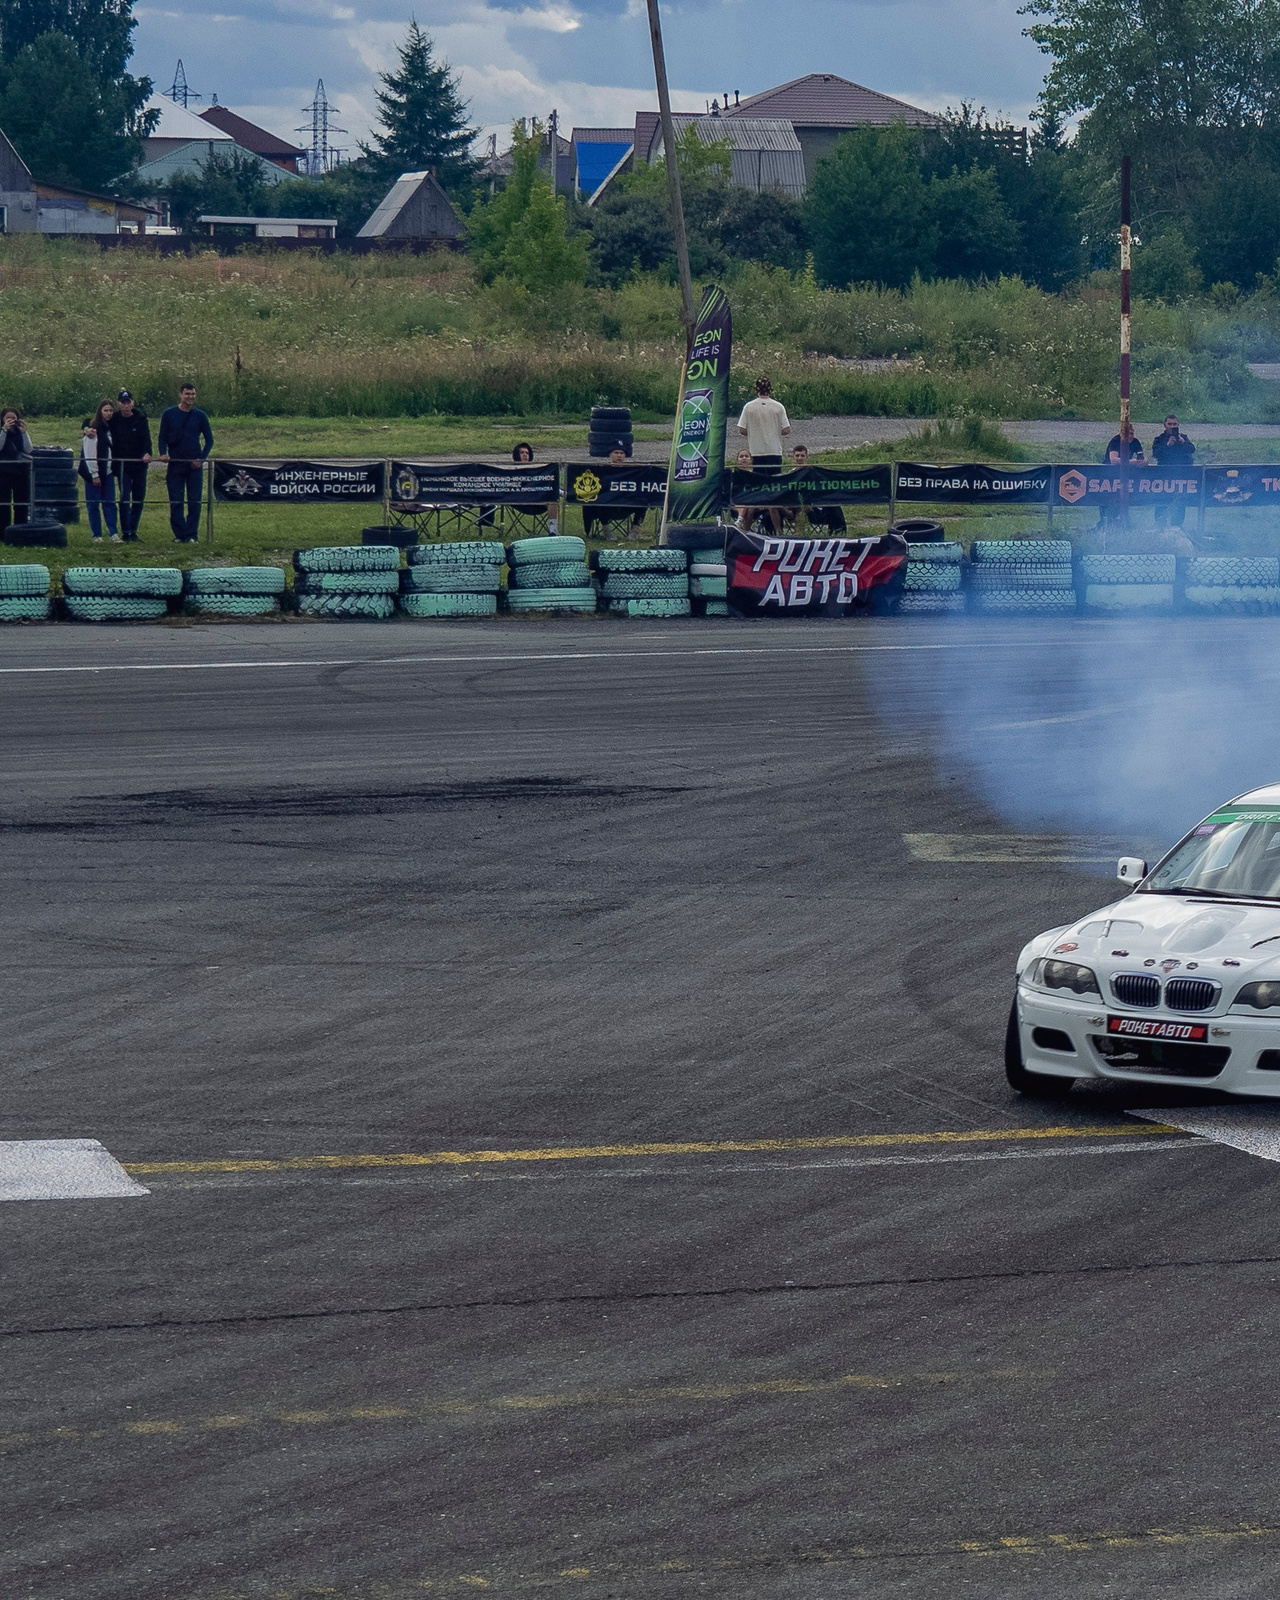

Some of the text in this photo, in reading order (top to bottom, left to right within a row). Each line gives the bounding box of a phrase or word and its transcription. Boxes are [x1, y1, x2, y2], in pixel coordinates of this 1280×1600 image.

[693, 328, 722, 347] EON
[690, 344, 720, 360] LIFE IS
[687, 358, 718, 381] ON
[684, 419, 706, 430] EON
[683, 428, 705, 437] ENERGY
[682, 460, 699, 468] KIWI
[275, 471, 368, 481] ИНЖЕНЕРНЫЕ
[679, 467, 700, 477] BLAST
[270, 482, 376, 494] ВОЙСКА РОССИИ
[609, 481, 637, 492] БЕЗ
[819, 479, 880, 491] ТЮМЕНЬ
[898, 477, 1047, 490] БЕЗ ПРАВА НА ОШИБКУ
[1088, 479, 1198, 494] SAFE ROUTE
[752, 537, 881, 573] РОКЕТ
[757, 571, 858, 607] АВТО
[1235, 812, 1279, 821] DRIFT
